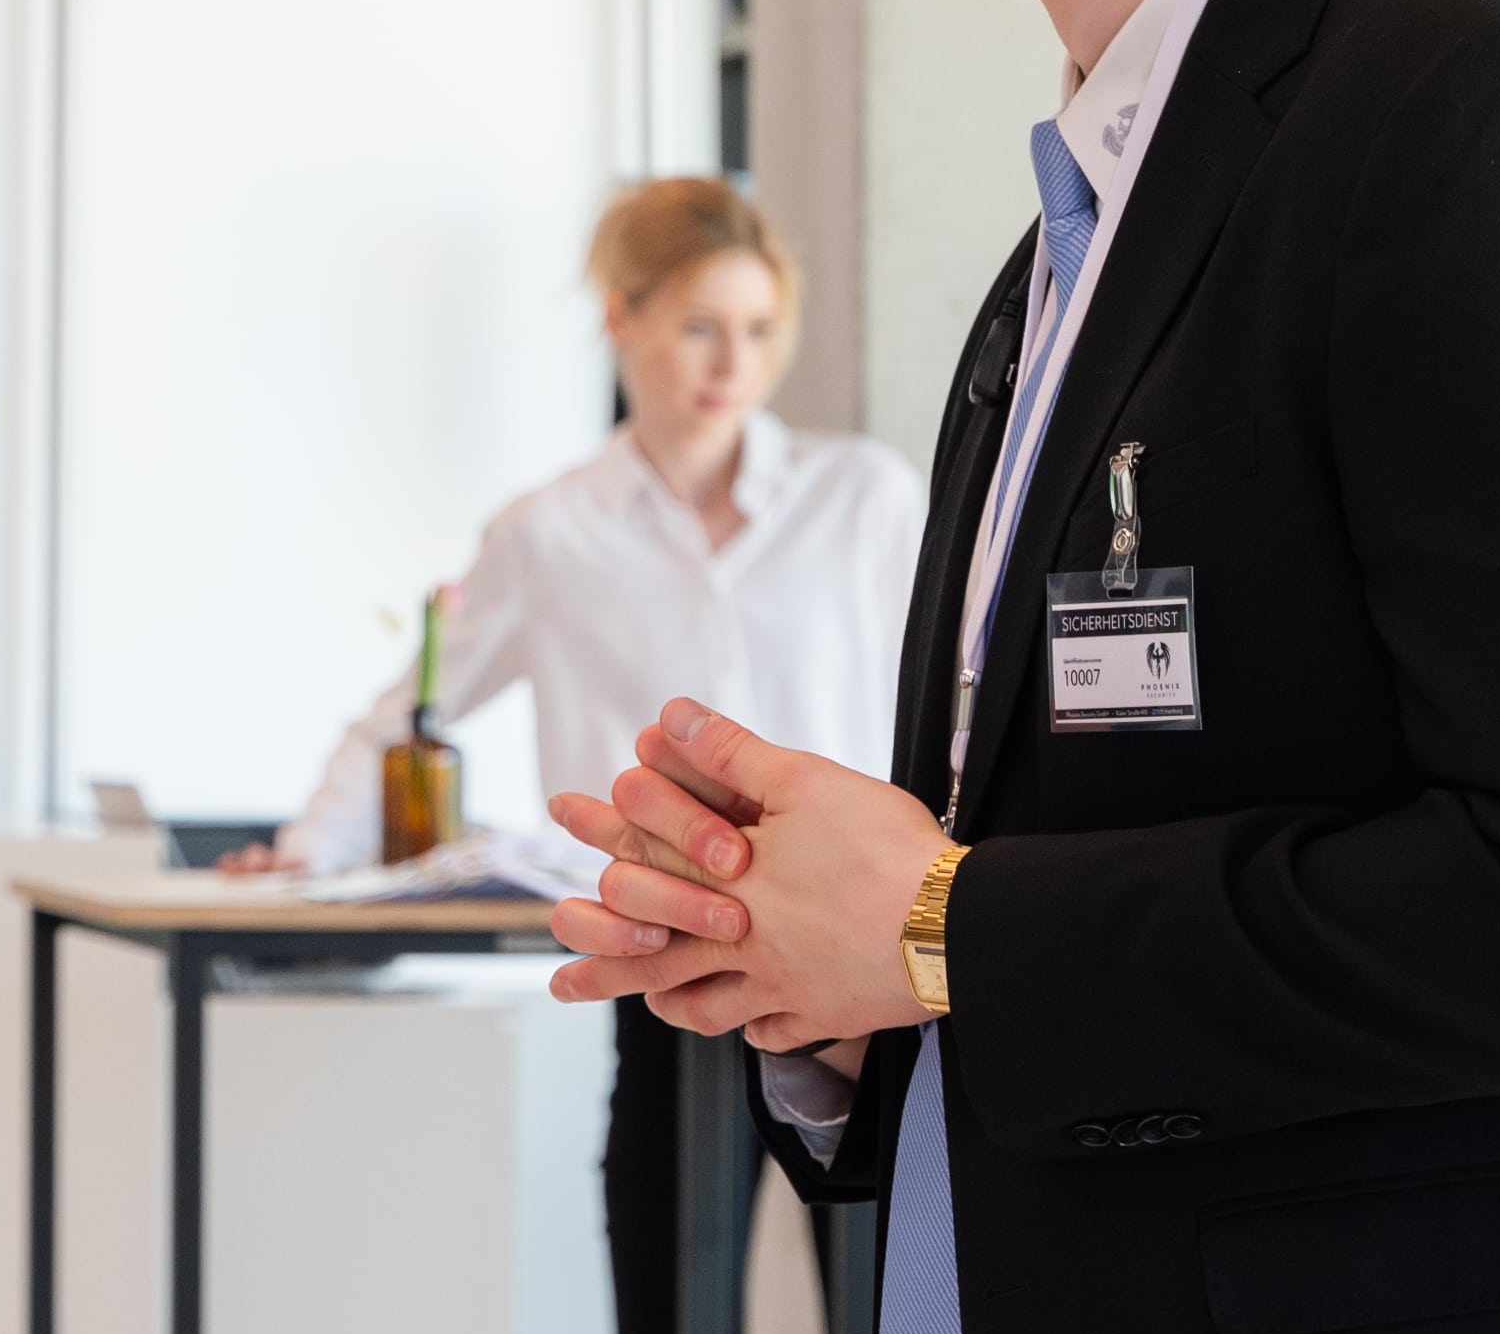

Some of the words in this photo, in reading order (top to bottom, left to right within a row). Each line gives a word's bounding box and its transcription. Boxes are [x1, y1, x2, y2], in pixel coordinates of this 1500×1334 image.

[1062, 612, 1178, 632] SICHERHEITSDIENST
[1064, 668, 1101, 687] 10007
[1141, 683, 1180, 691] PHOENIX
